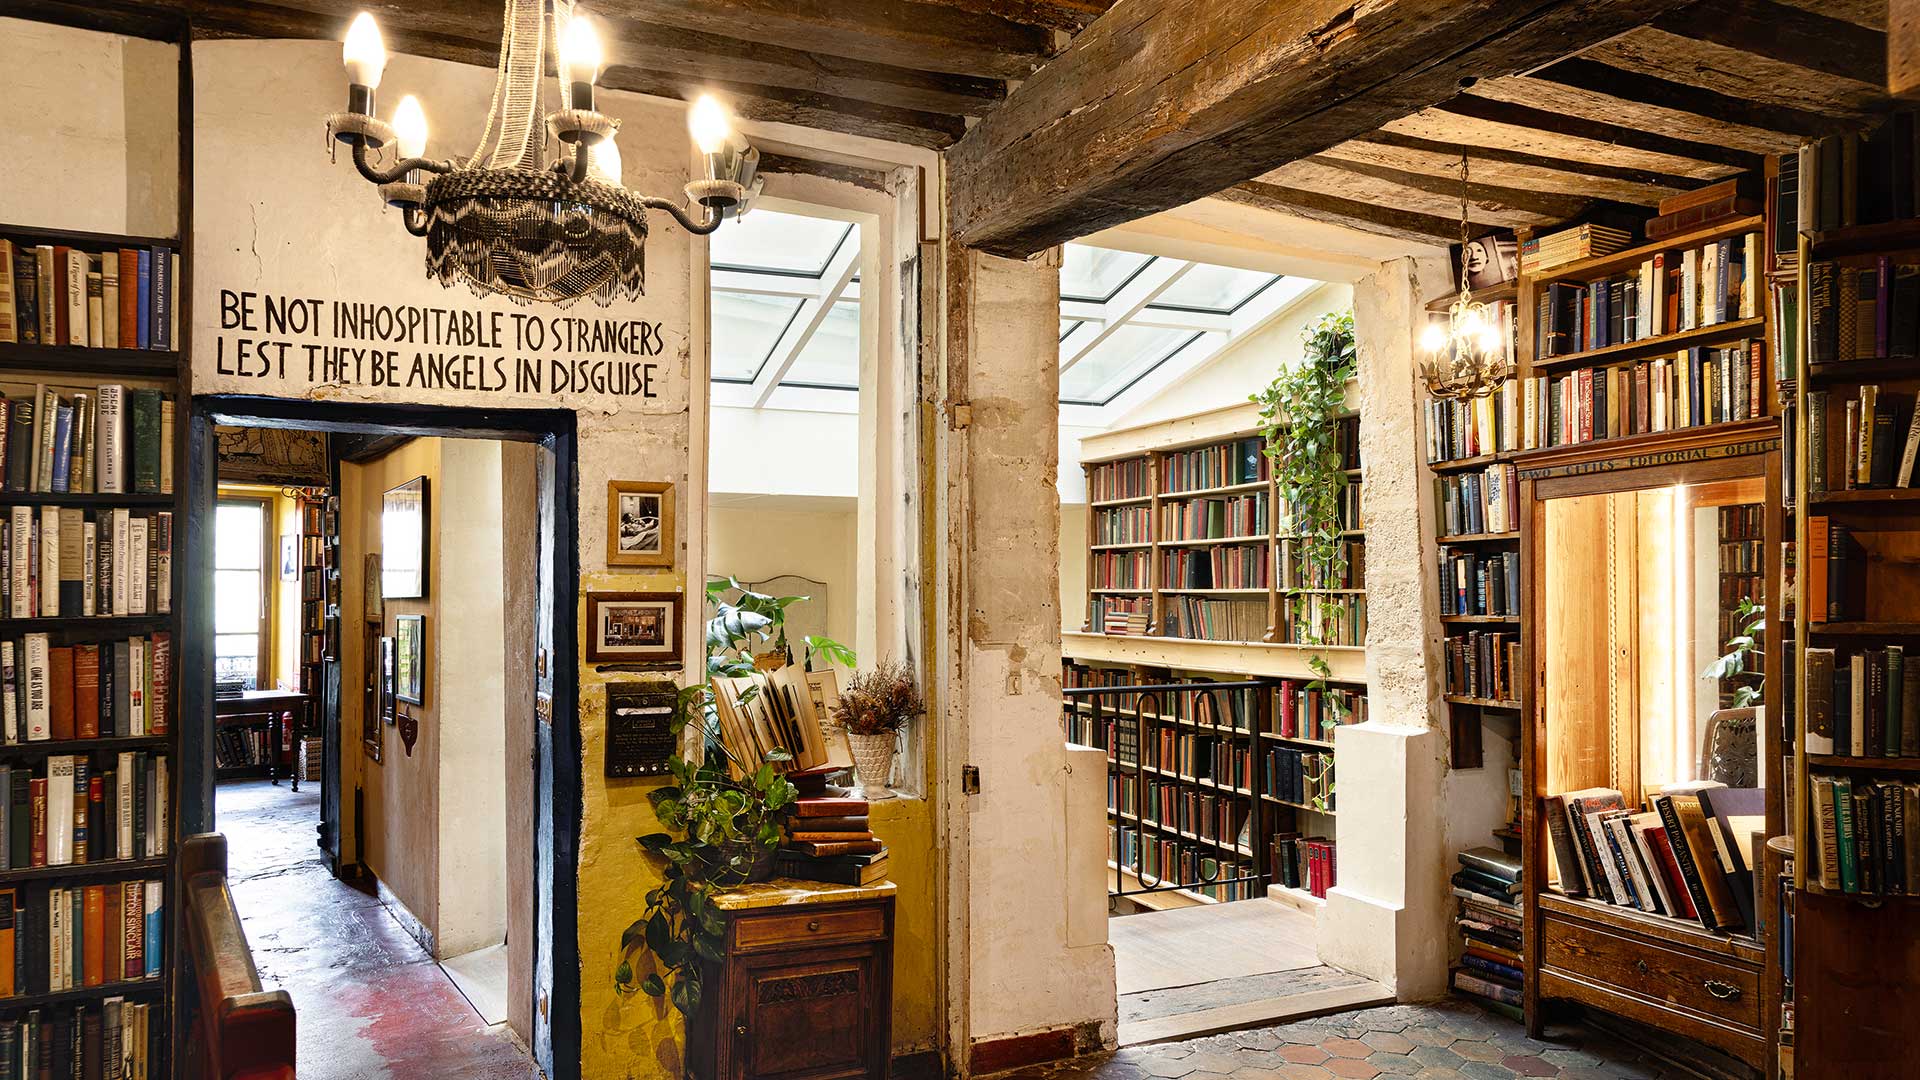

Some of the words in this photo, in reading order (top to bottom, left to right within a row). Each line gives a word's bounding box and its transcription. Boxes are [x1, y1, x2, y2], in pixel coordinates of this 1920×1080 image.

[220, 289, 256, 330] BE
[265, 295, 323, 336] NOT
[333, 300, 502, 348] INHOSPITABLE
[510, 313, 545, 352] TO
[551, 318, 663, 356] STRANGERS
[217, 336, 288, 379] LEST
[302, 344, 366, 385] THEY
[372, 350, 399, 387] BE
[408, 354, 506, 392] ANGELS
[516, 358, 541, 394] IN
[551, 360, 658, 398] DISGUISE
[101, 388, 109, 416] WILDE
[110, 388, 118, 416] OSCAR
[1860, 421, 1868, 463] STALIN
[1520, 468, 1552, 480] TWO
[1566, 461, 1614, 476] CITIES
[1629, 447, 1710, 468] EDITORIAL
[1726, 440, 1780, 456] OFFICE
[15, 513, 27, 526] Bob
[15, 527, 27, 560] Woodward
[15, 563, 27, 576] The
[12, 577, 26, 602] Agenda
[30, 667, 43, 681] COME
[152, 640, 169, 684] Werner
[31, 689, 43, 700] YOU
[31, 701, 43, 711] ARE
[152, 685, 169, 727] Erhard
[1659, 800, 1678, 831] DESERT
[1671, 830, 1694, 876] PAGEANTRY
[126, 884, 137, 917] UPTON
[125, 918, 137, 960] SINCLAIR
